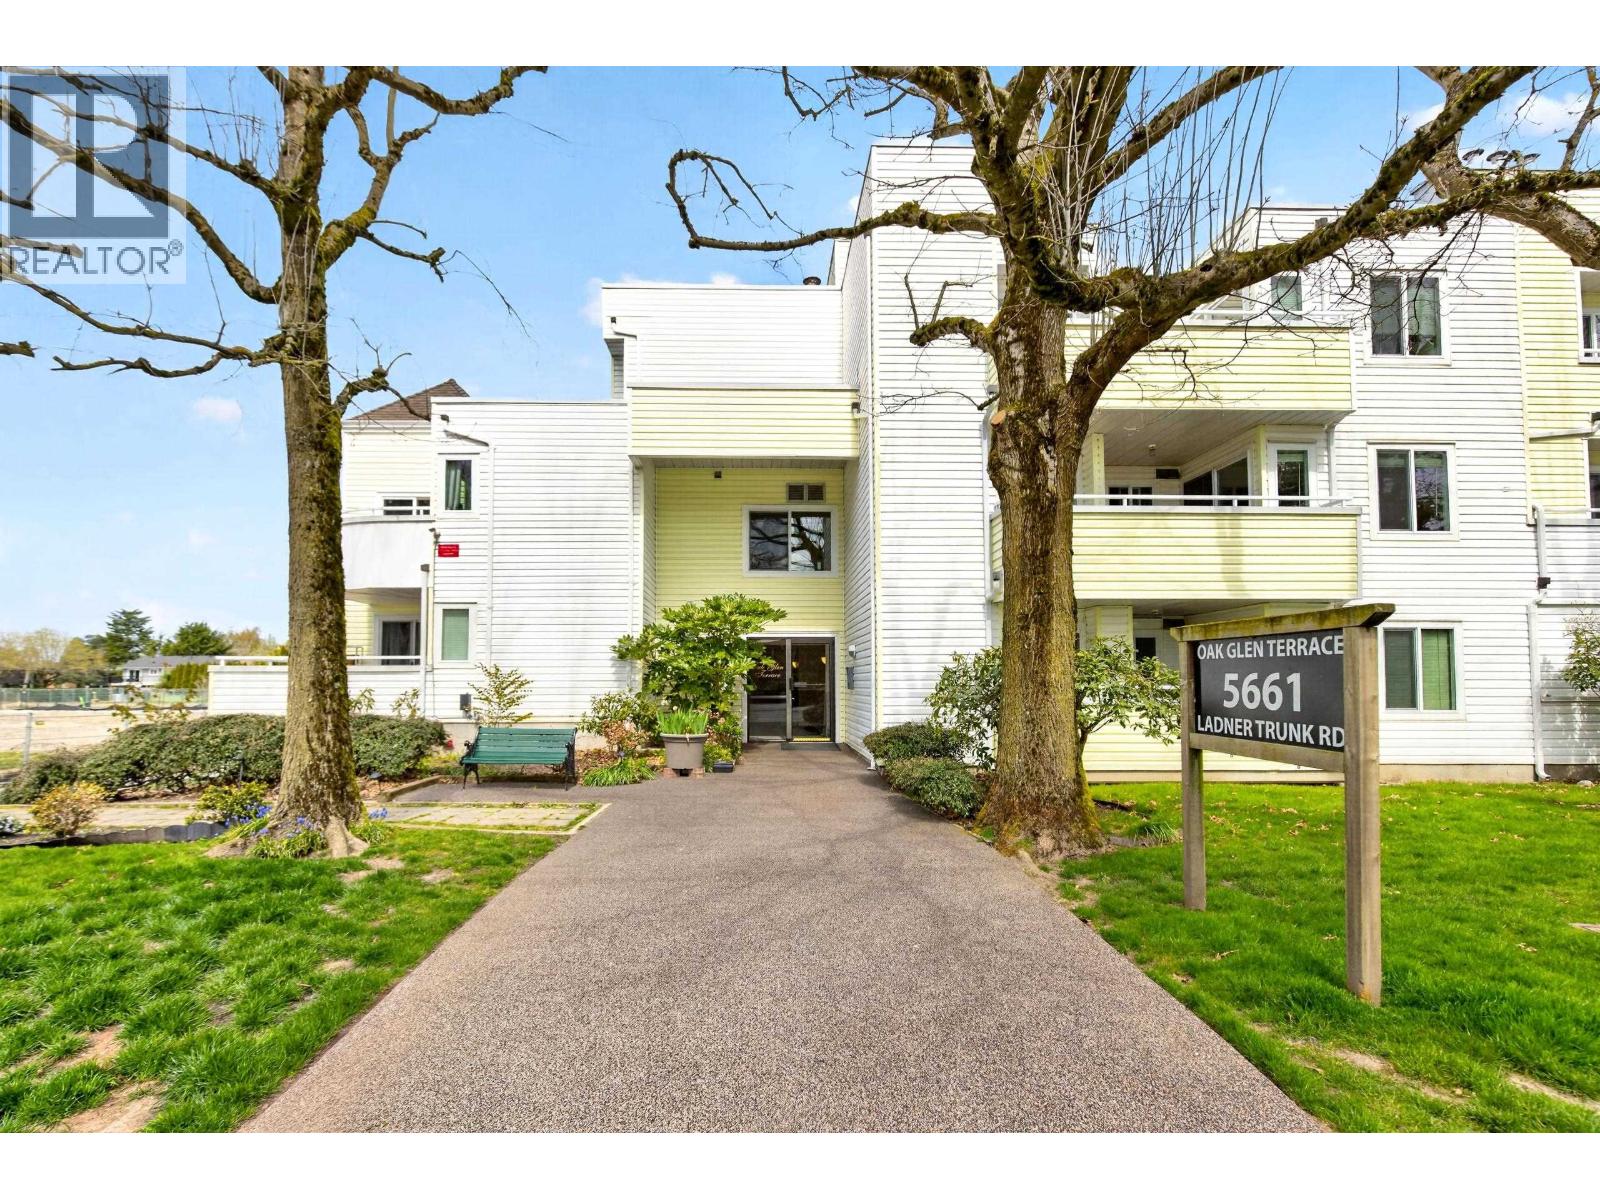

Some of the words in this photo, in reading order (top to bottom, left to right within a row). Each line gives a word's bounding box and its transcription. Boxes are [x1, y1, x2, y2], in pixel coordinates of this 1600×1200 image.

[1197, 645, 1224, 660] OAK
[1227, 640, 1264, 658] GLEN
[1267, 635, 1344, 657] TERRACE
[1223, 672, 1301, 712] 5661
[1197, 715, 1253, 737] LADNER
[1255, 720, 1315, 744] TRUNK
[1319, 725, 1345, 747] RD
